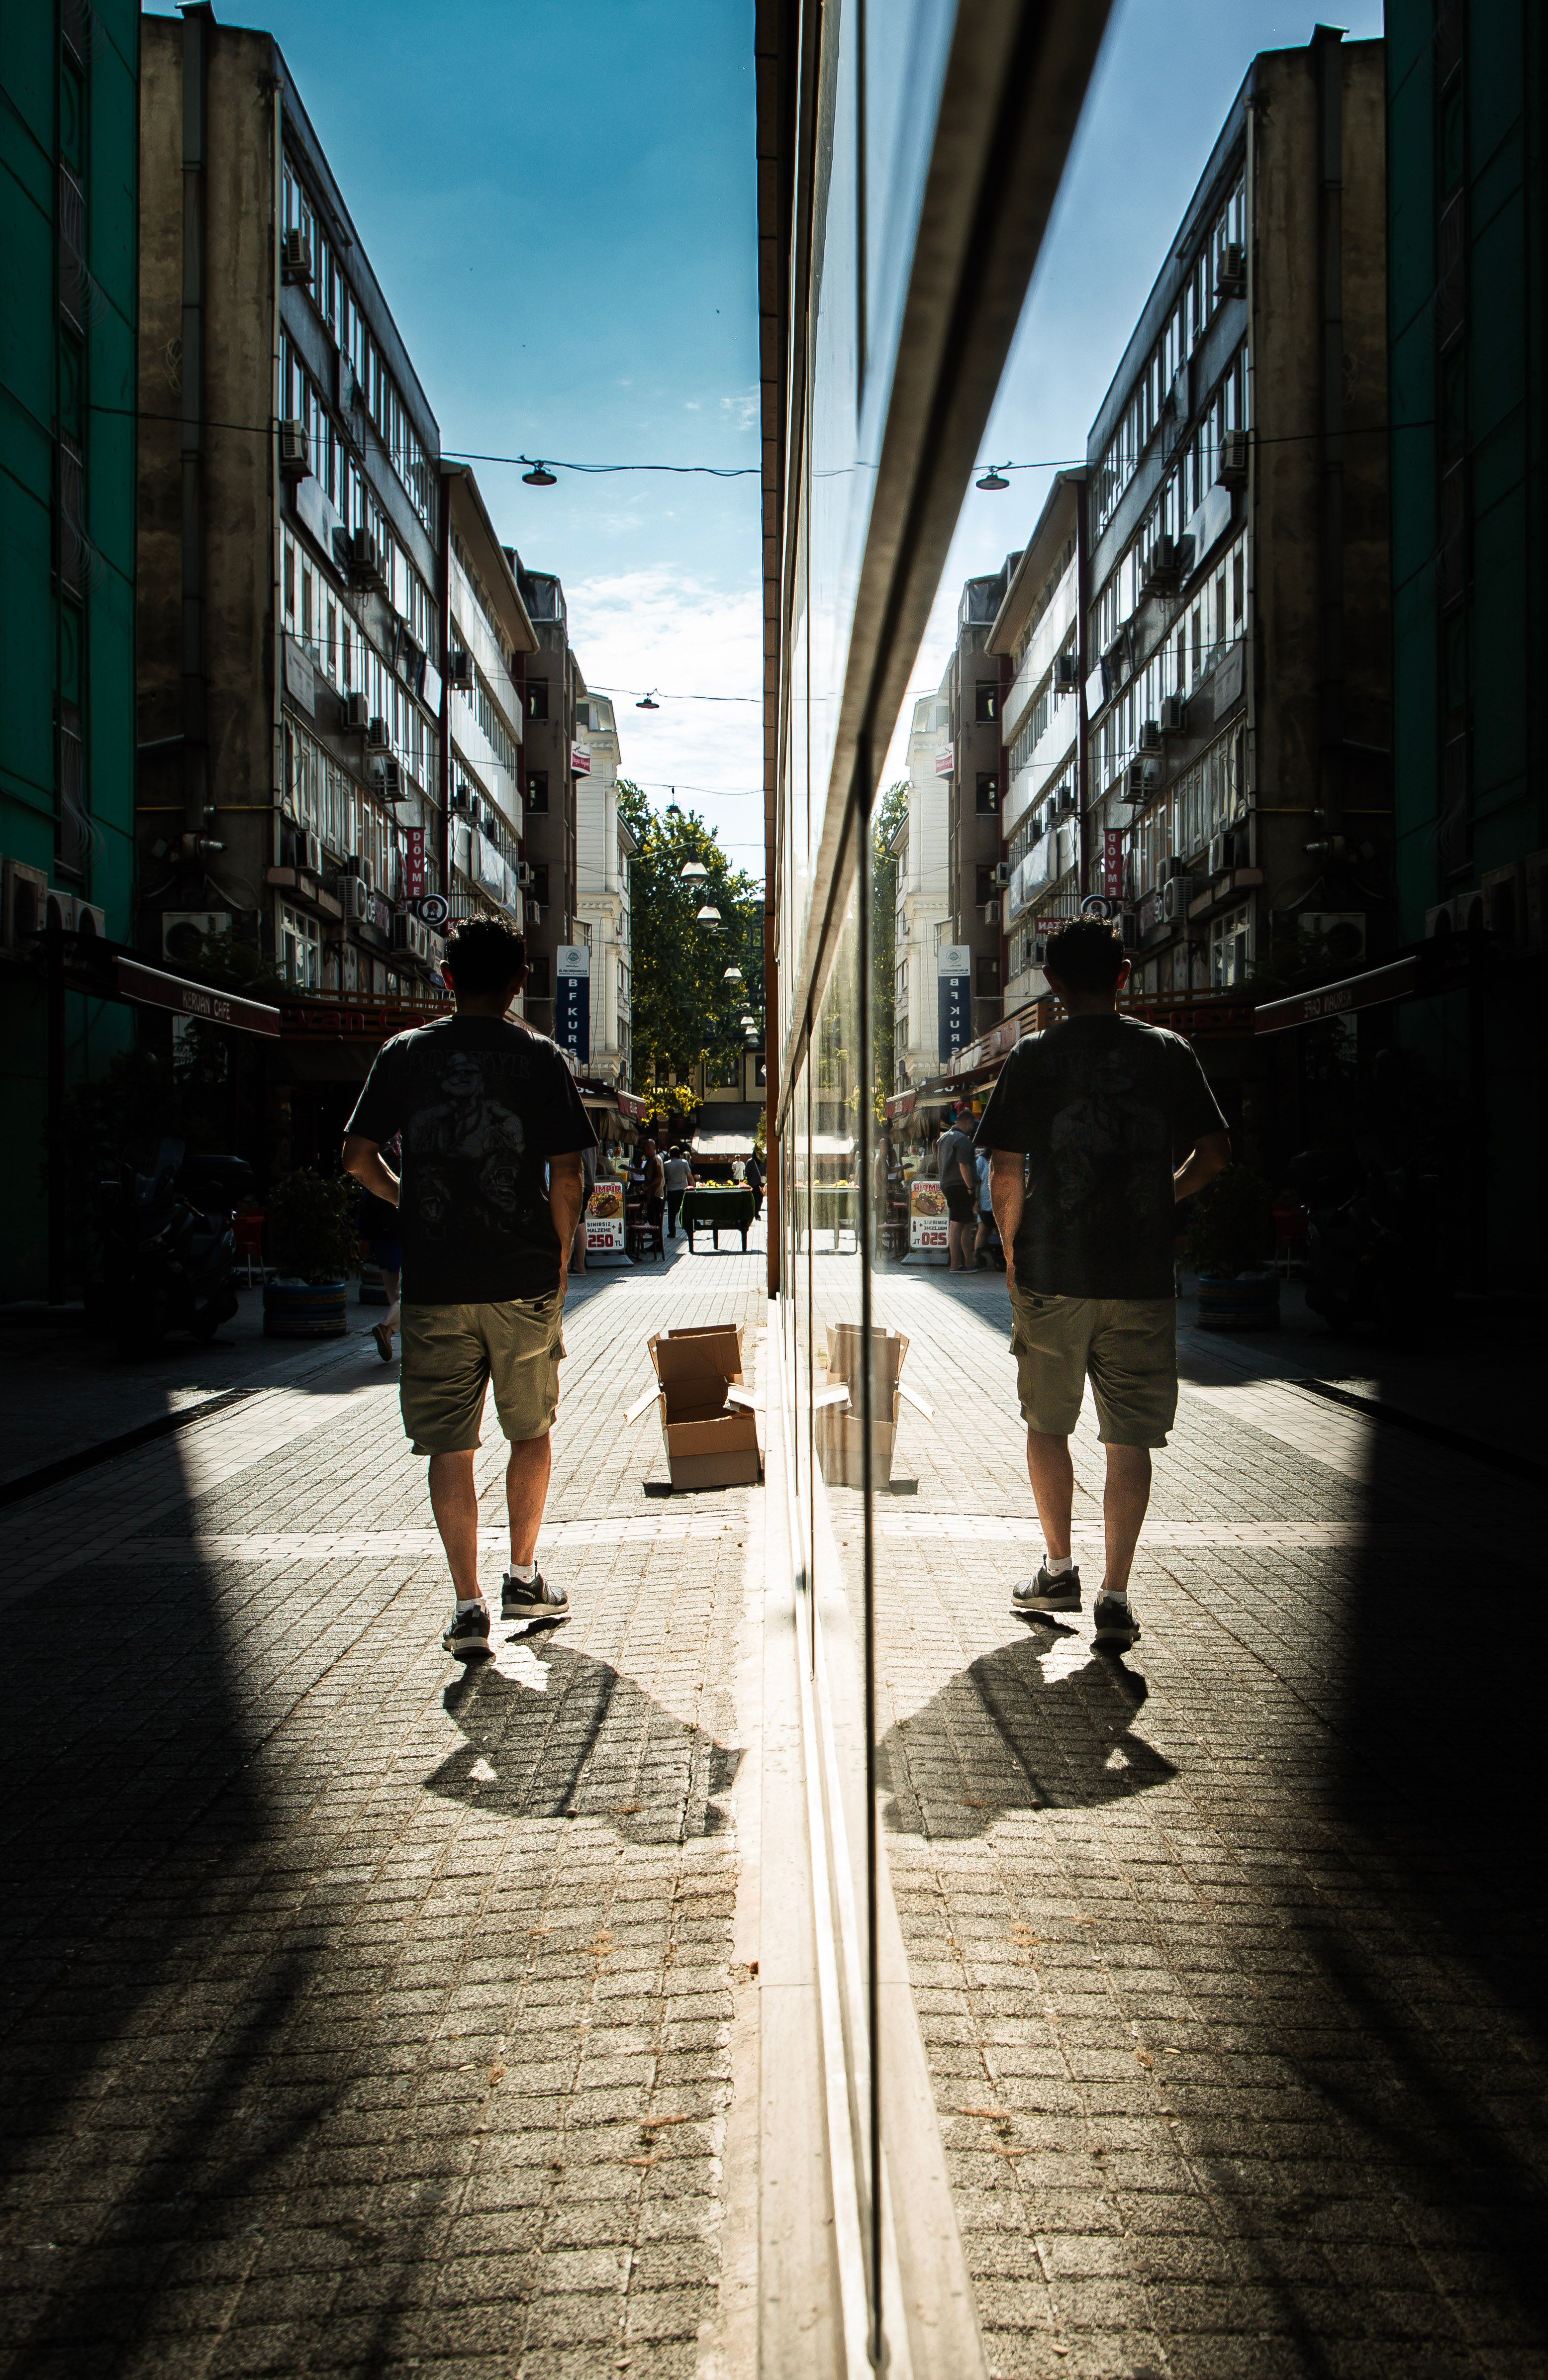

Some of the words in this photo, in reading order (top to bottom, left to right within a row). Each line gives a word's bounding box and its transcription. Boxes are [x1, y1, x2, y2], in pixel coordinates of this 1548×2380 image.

[412, 832, 422, 896] DÖVME
[182, 989, 210, 1015] KERVAN
[213, 998, 231, 1020] CAFE
[404, 1049, 532, 1078] POEYE
[588, 1234, 614, 1248] 250
